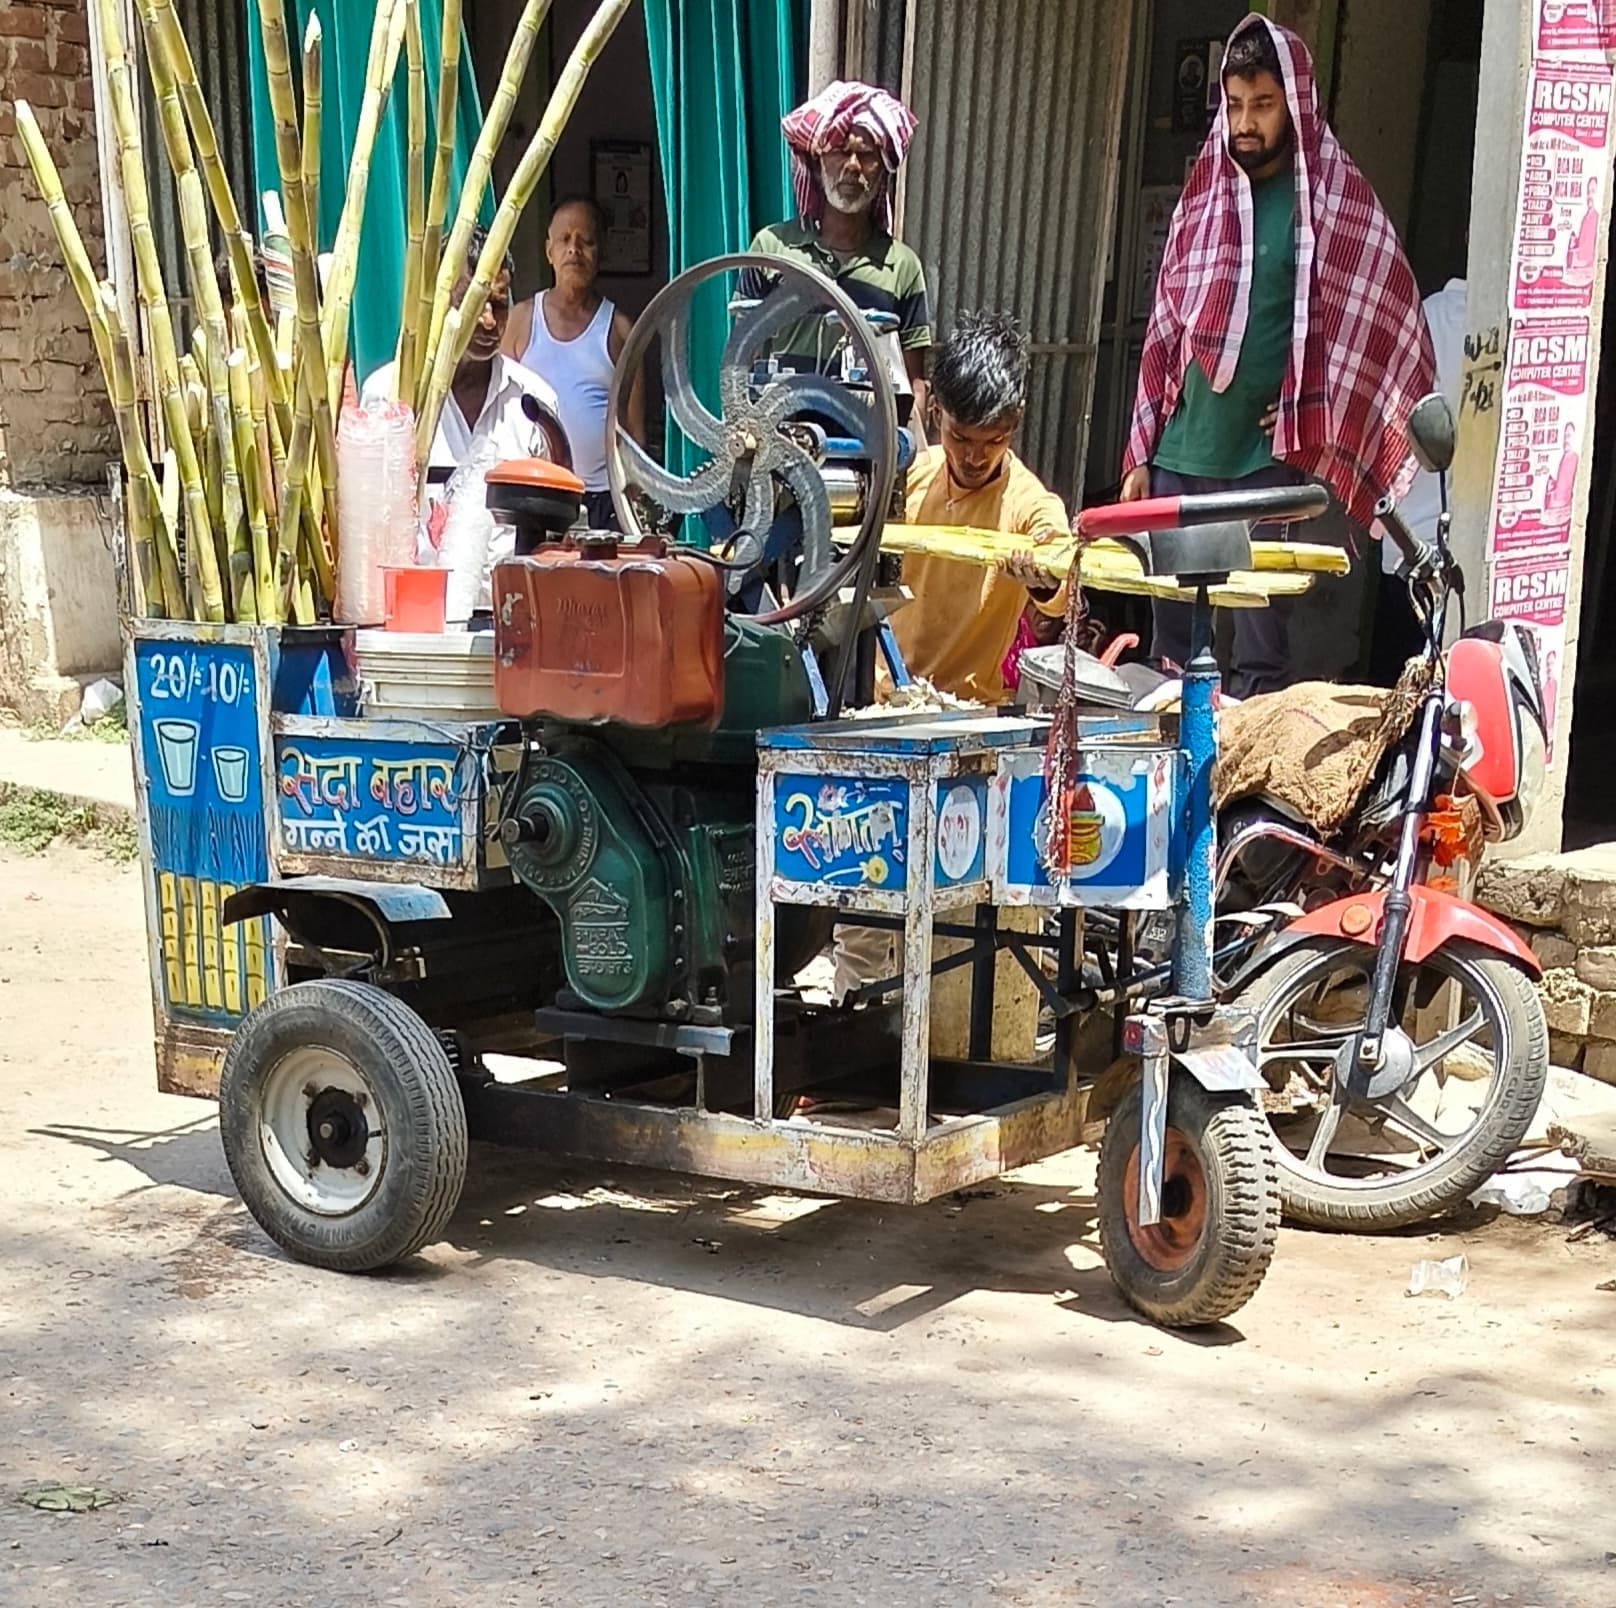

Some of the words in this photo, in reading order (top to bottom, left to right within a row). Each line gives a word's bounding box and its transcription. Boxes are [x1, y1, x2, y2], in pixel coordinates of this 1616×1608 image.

[1534, 79, 1611, 113] RCSM
[1531, 111, 1575, 128] COMPUTER
[1575, 114, 1606, 129] CENTRE
[1512, 335, 1587, 367] RCSM
[1511, 366, 1552, 381] COMPUTER
[1552, 364, 1582, 378] CENTRE
[1495, 569, 1568, 604] RCSM
[1494, 600, 1534, 618] COMPUTER
[1534, 597, 1564, 611] CENTRE
[281, 746, 363, 815] सदा
[369, 757, 460, 815] बहार
[282, 808, 351, 855] गन्ने
